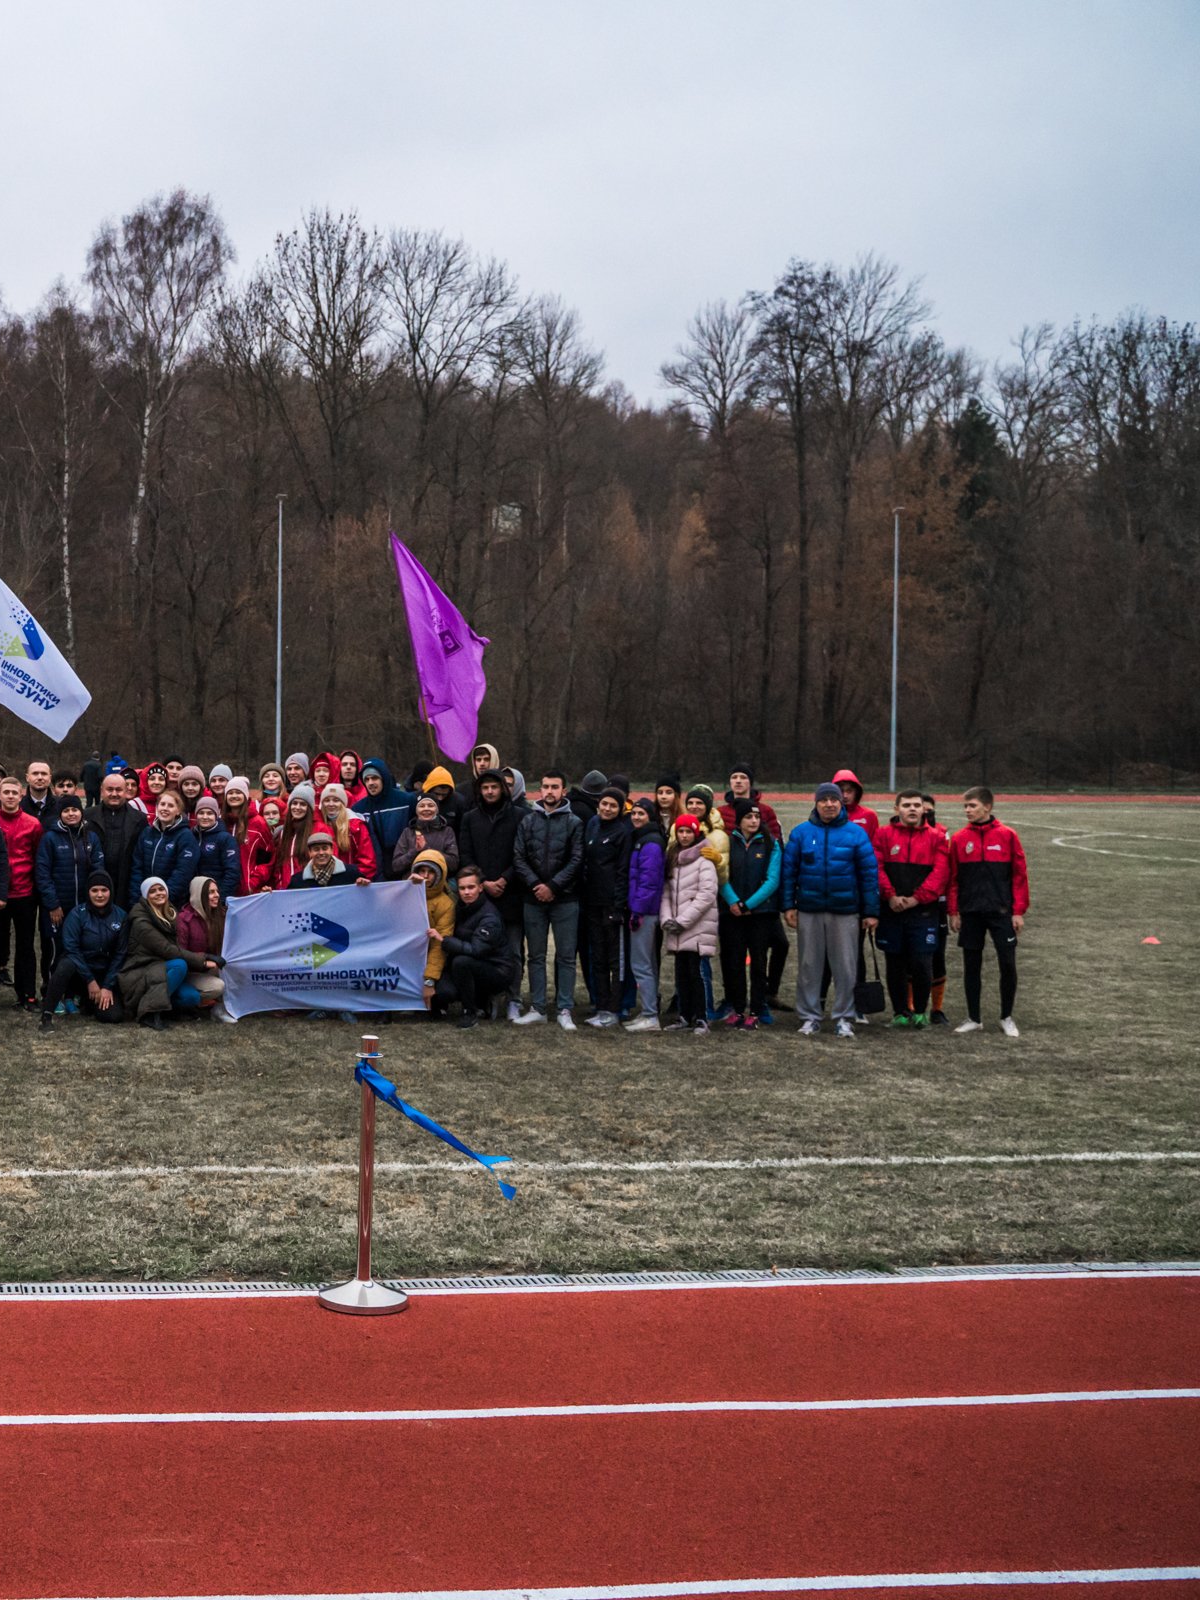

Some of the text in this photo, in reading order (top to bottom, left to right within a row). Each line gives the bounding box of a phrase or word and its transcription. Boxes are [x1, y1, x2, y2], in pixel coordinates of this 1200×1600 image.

[1, 660, 60, 705] ІННОВАТИКИ
[16, 682, 55, 710] ЗУНУ
[252, 966, 400, 981] ІНСТИТУТ ІННОВАТИКИ
[350, 978, 400, 991] ЗУНУ
